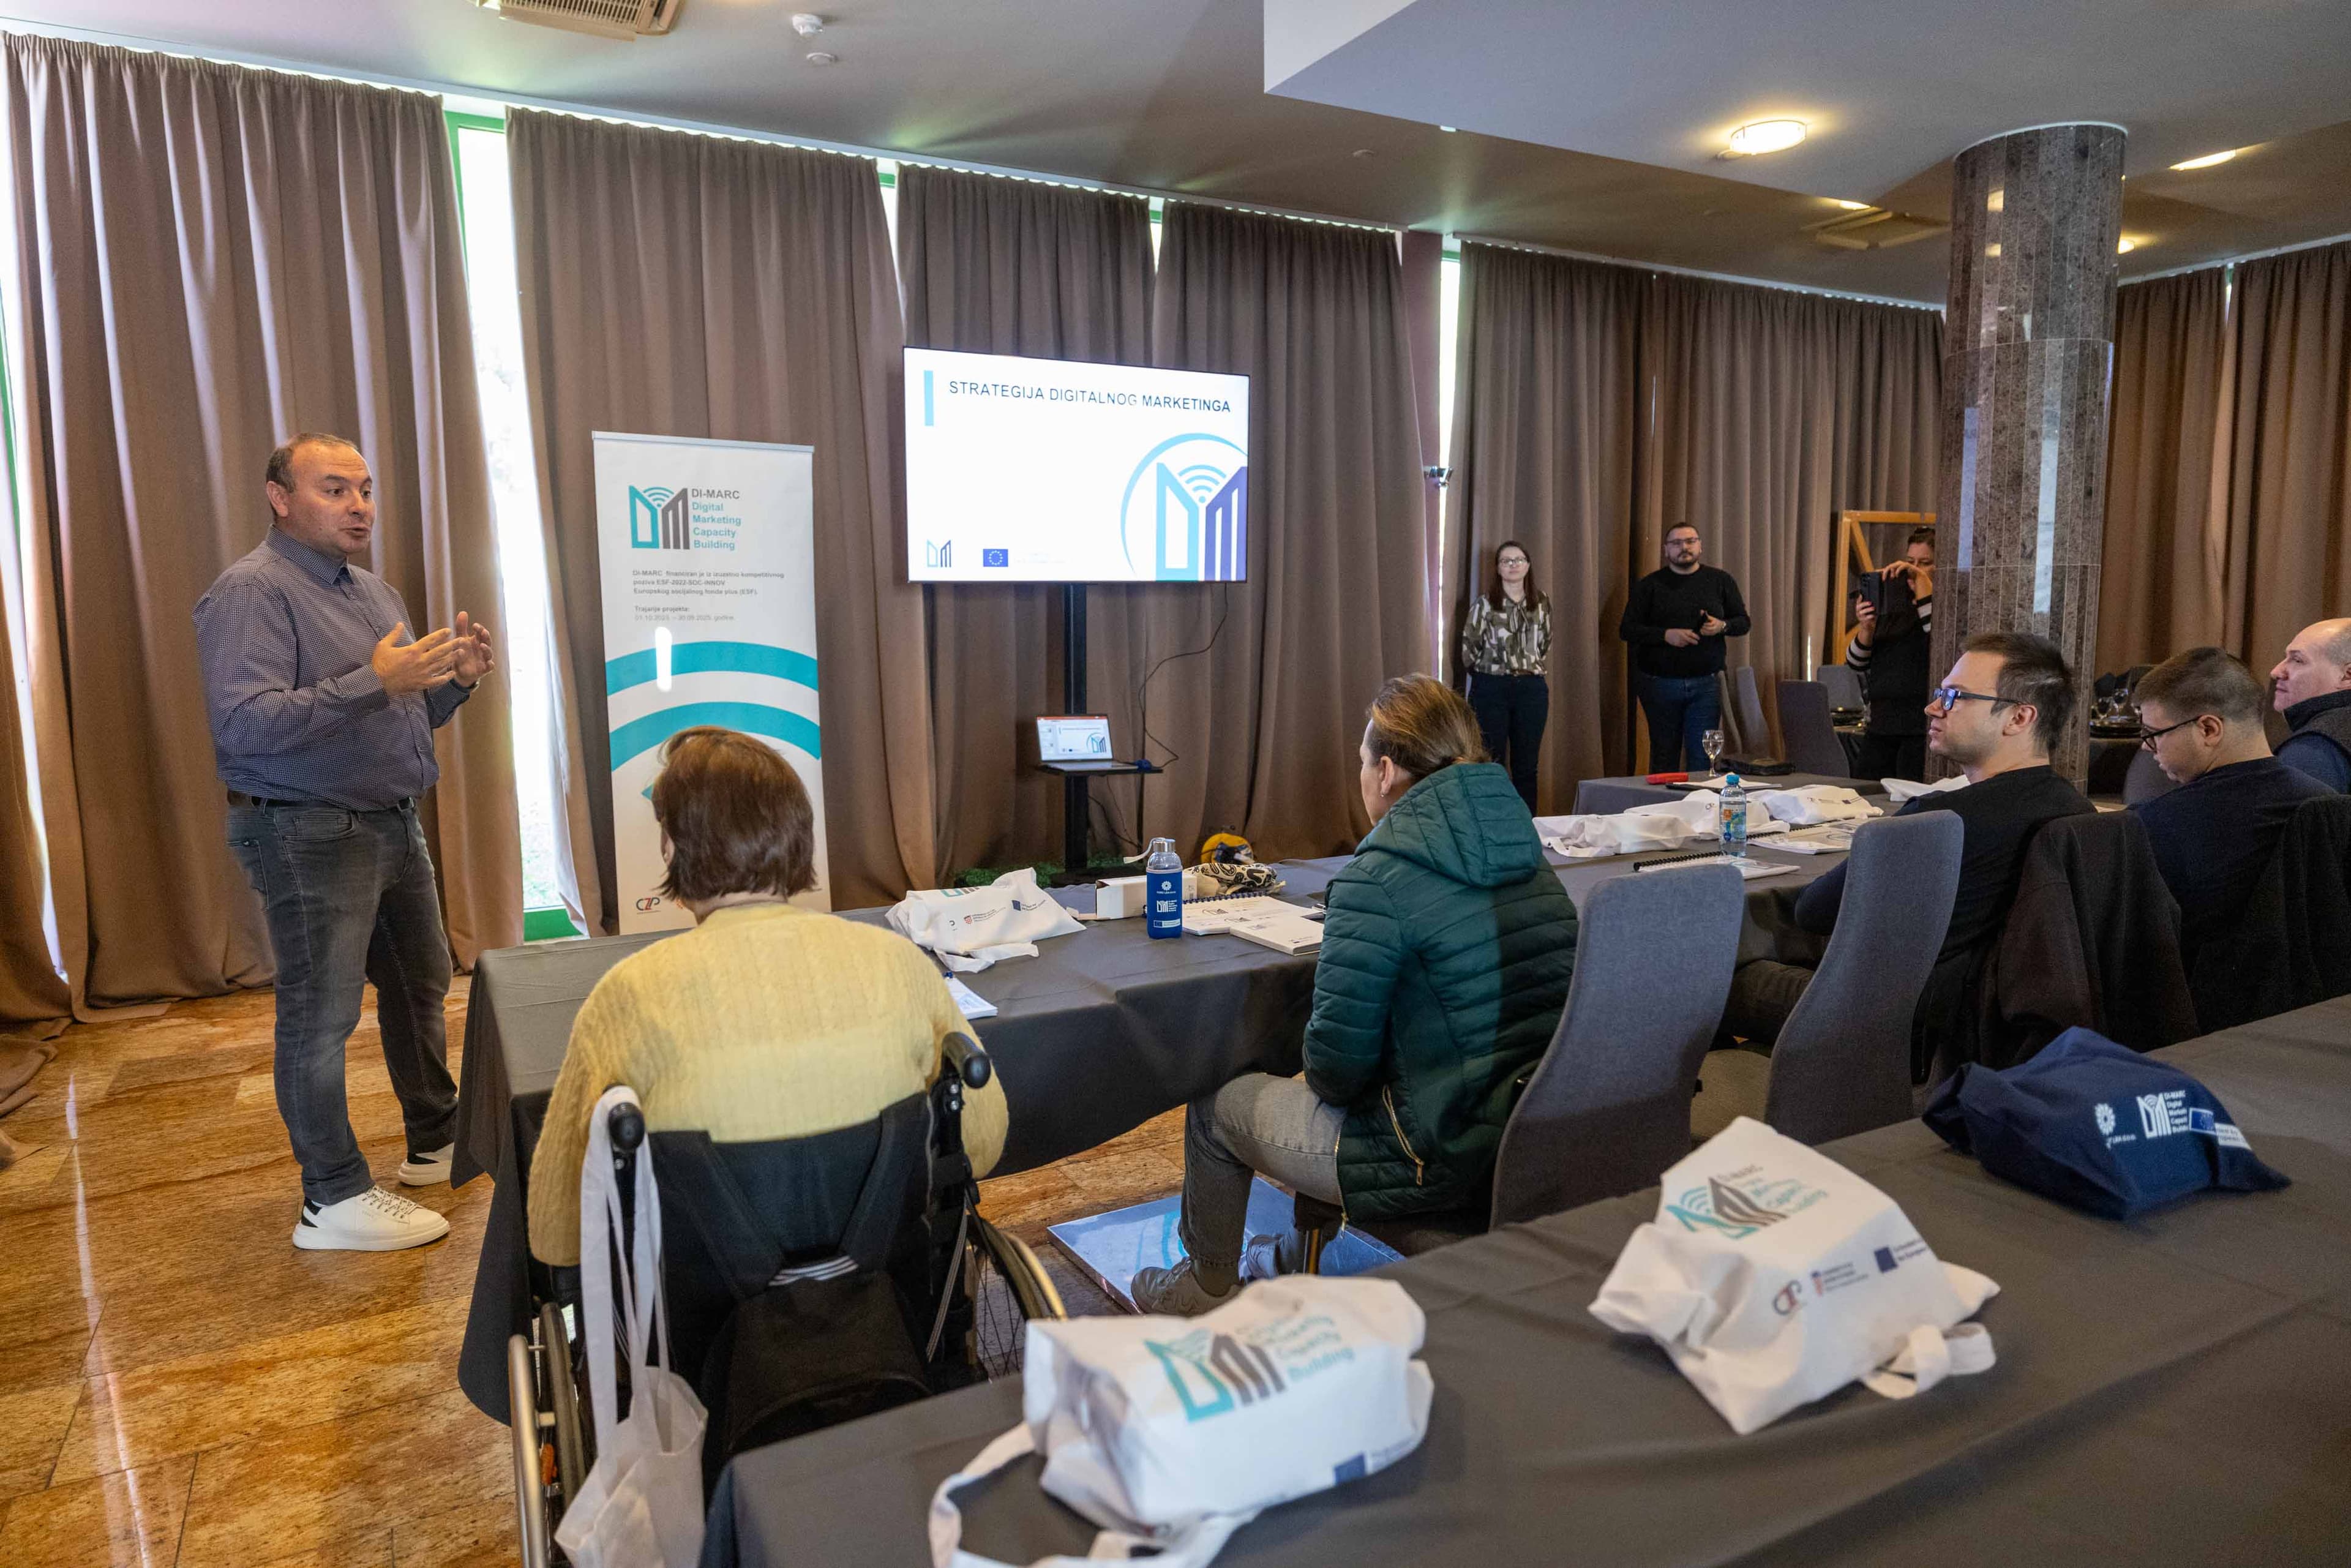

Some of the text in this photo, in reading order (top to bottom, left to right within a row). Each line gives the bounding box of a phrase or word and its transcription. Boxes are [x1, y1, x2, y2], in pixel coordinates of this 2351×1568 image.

[949, 380, 1231, 413] STRATEGIJA DIGITALNOG MARKETINGA
[691, 489, 740, 500] DI-MARC
[692, 502, 724, 512] Digital
[692, 514, 741, 527] Marketing
[693, 527, 736, 539] Capacity
[694, 540, 735, 551] Building
[636, 897, 661, 911] CZP
